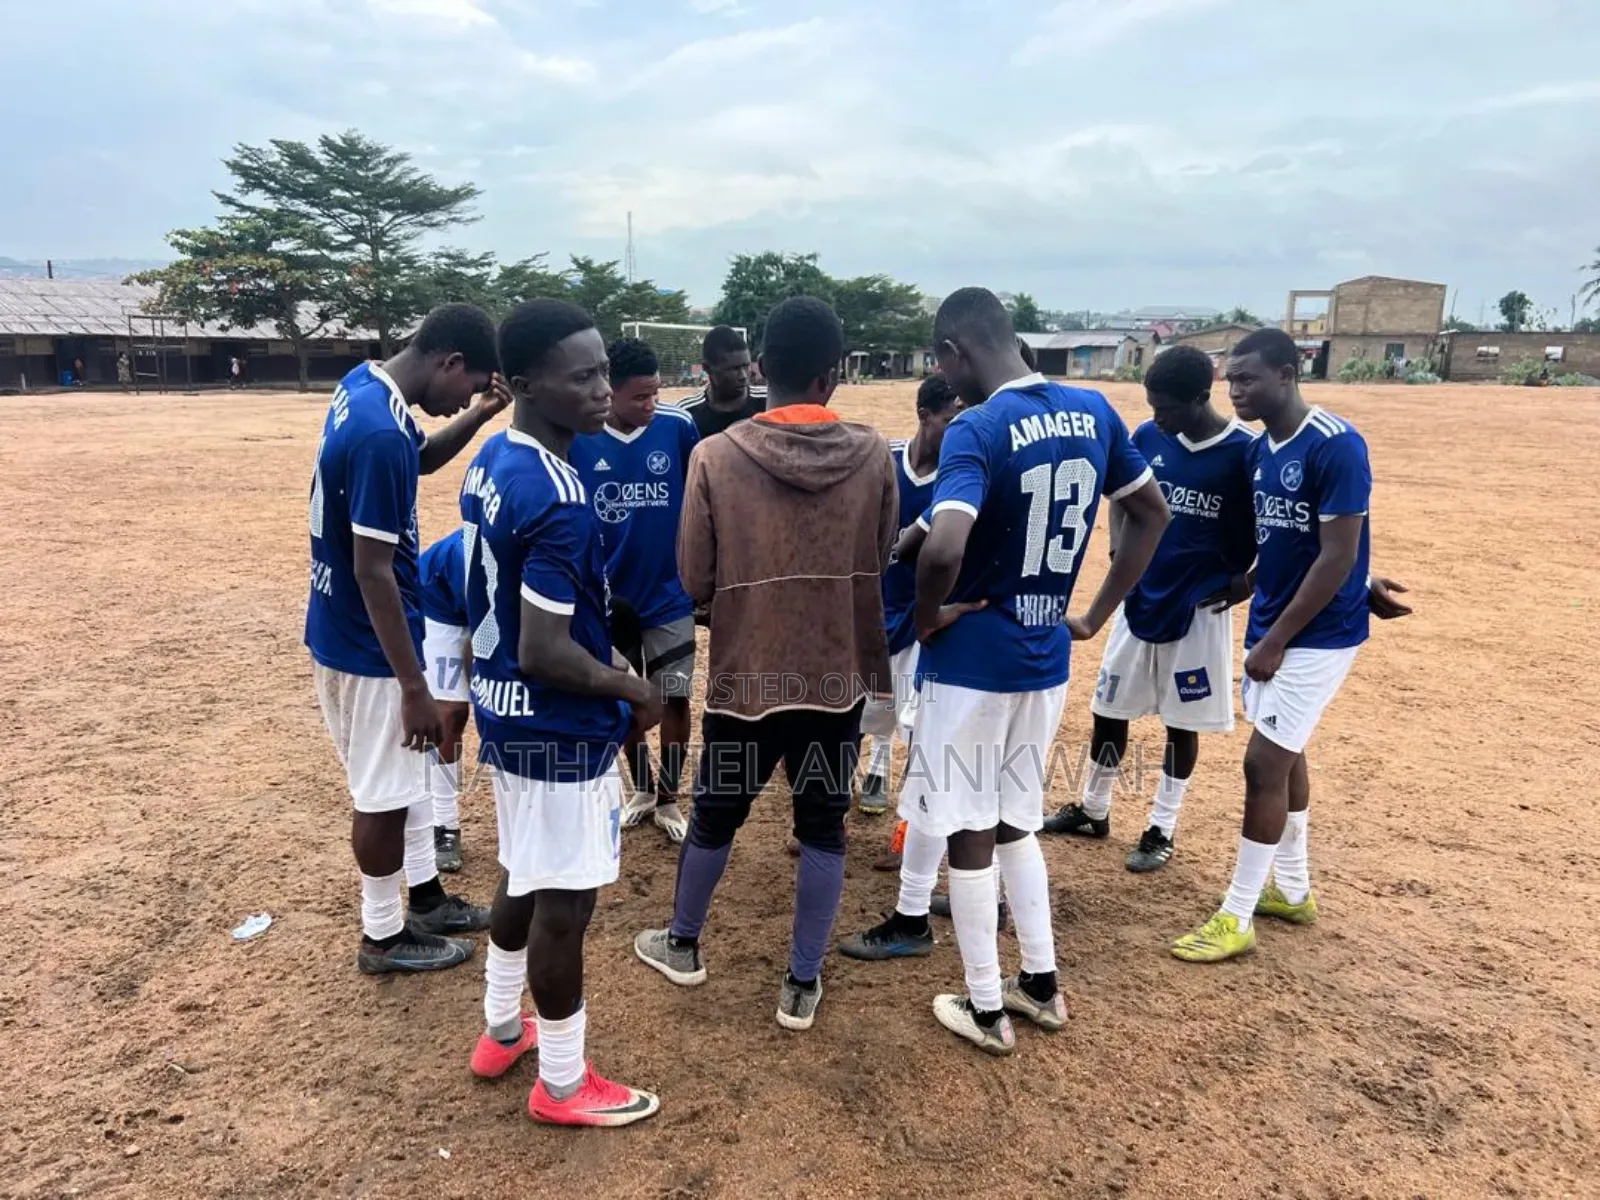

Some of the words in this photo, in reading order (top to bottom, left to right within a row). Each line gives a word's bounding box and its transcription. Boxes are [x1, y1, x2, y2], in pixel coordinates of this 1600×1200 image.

[1009, 411, 1097, 451] AMAGER
[621, 482, 669, 501] ØENS
[1171, 486, 1223, 511] ØENS
[1020, 457, 1097, 578] 13
[434, 657, 463, 690] 17
